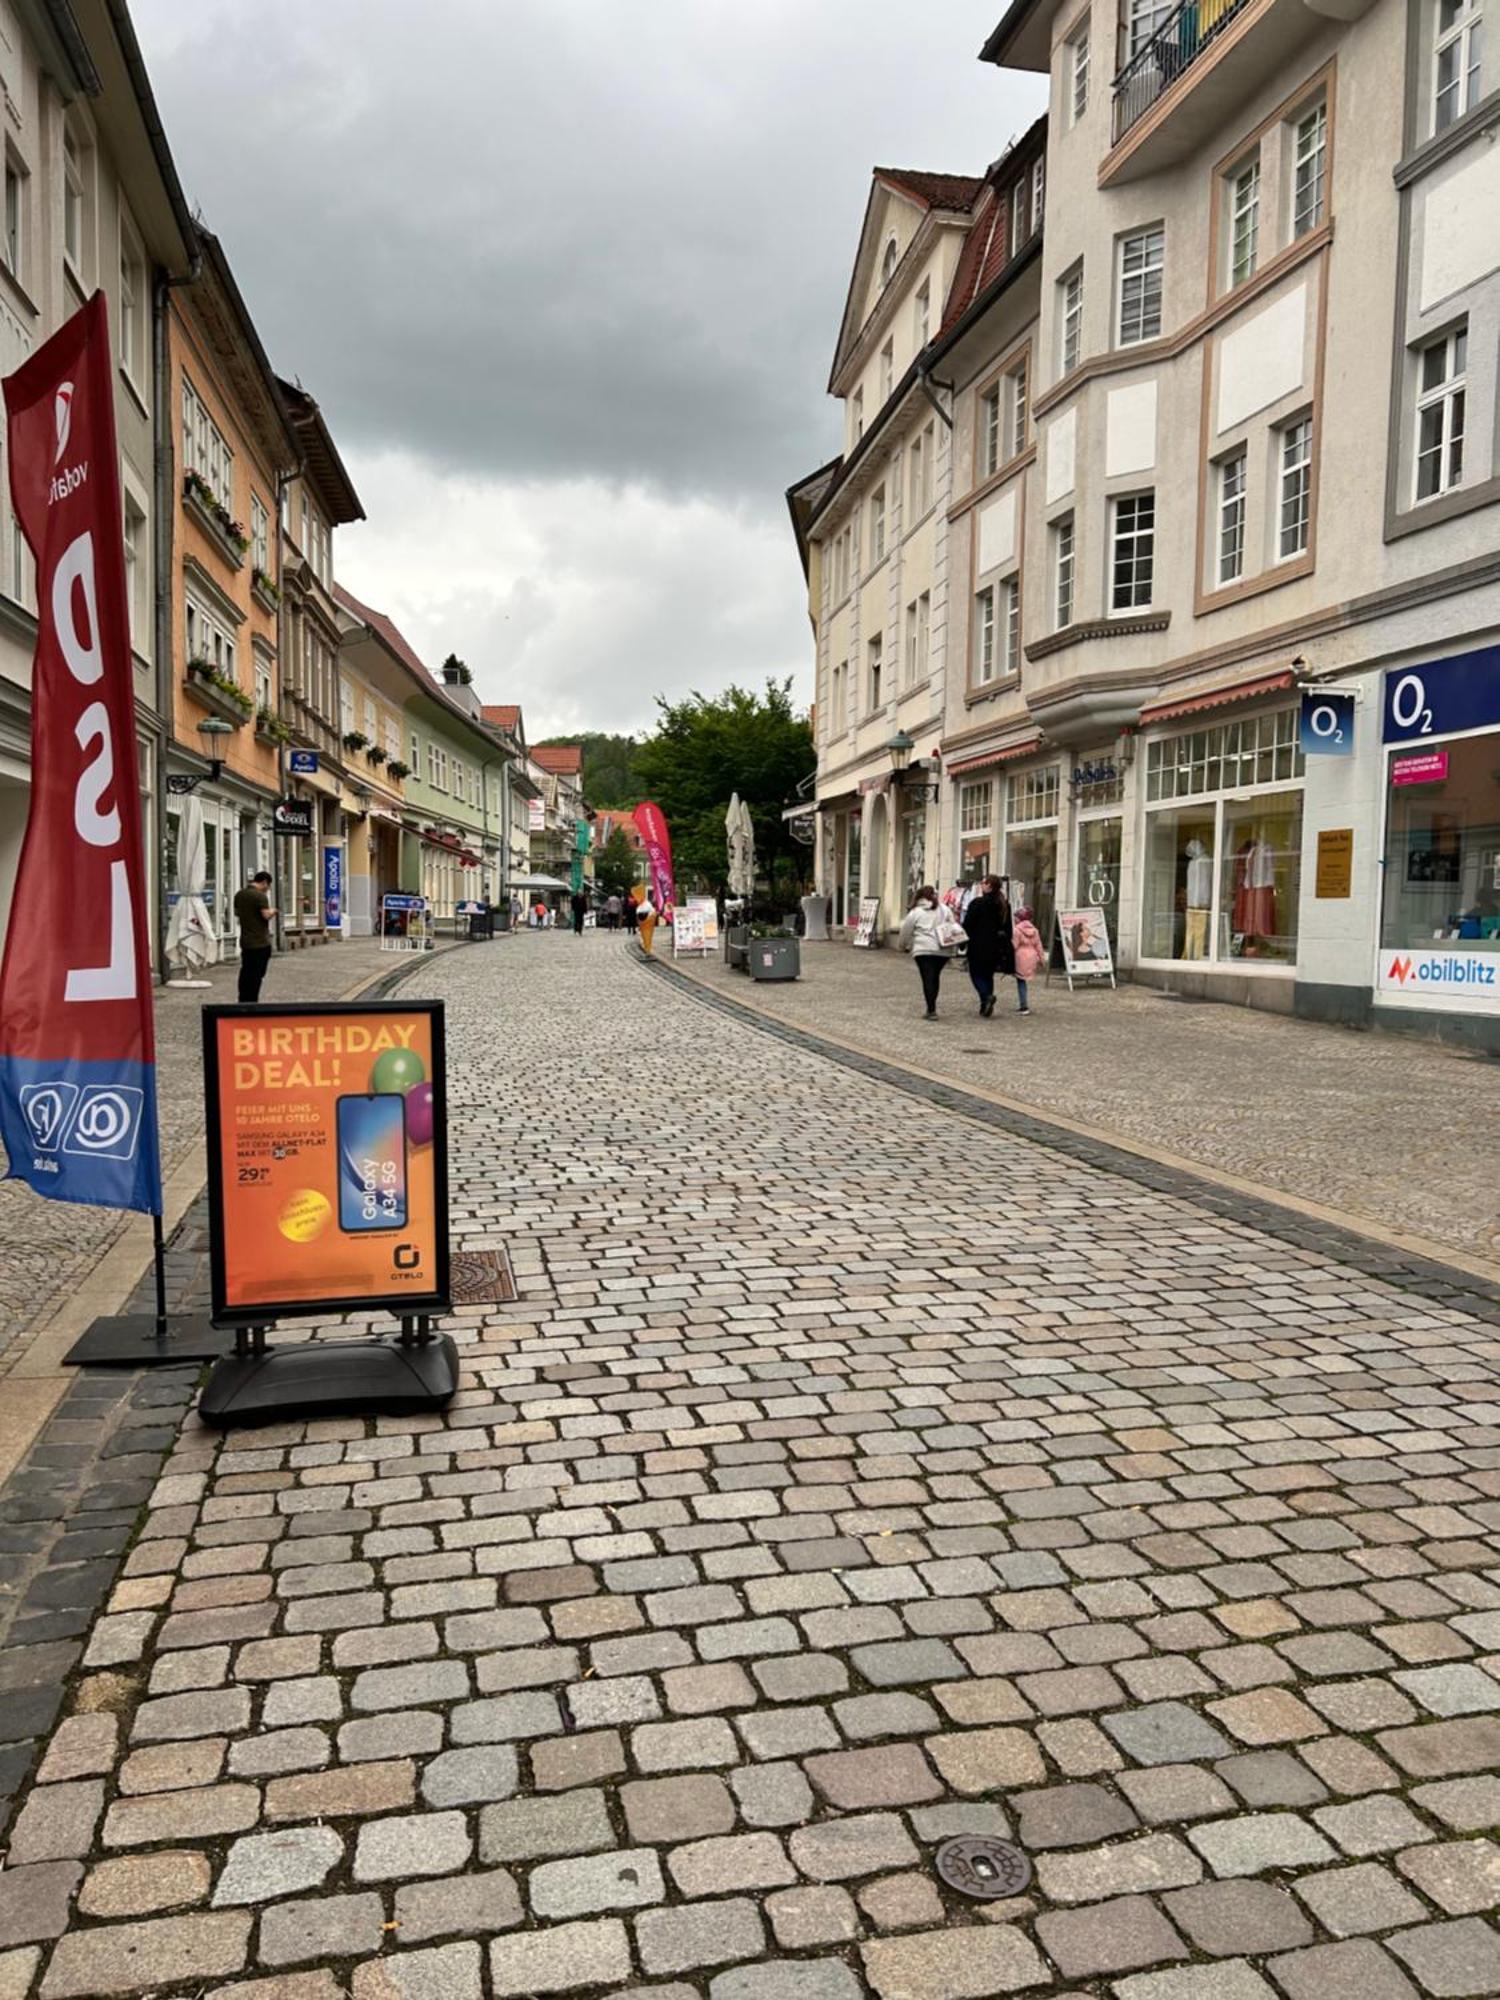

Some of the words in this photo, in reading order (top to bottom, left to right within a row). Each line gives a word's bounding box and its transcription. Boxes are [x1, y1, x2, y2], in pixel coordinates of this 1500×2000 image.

[328, 856, 340, 890] Apollo
[233, 1024, 417, 1057] BIRTHDAY
[234, 1059, 342, 1089] DEAL!
[285, 1113, 321, 1123] OTELO
[382, 1160, 397, 1183] 5G
[362, 1158, 380, 1220] Galaxy
[382, 1188, 398, 1218] A34
